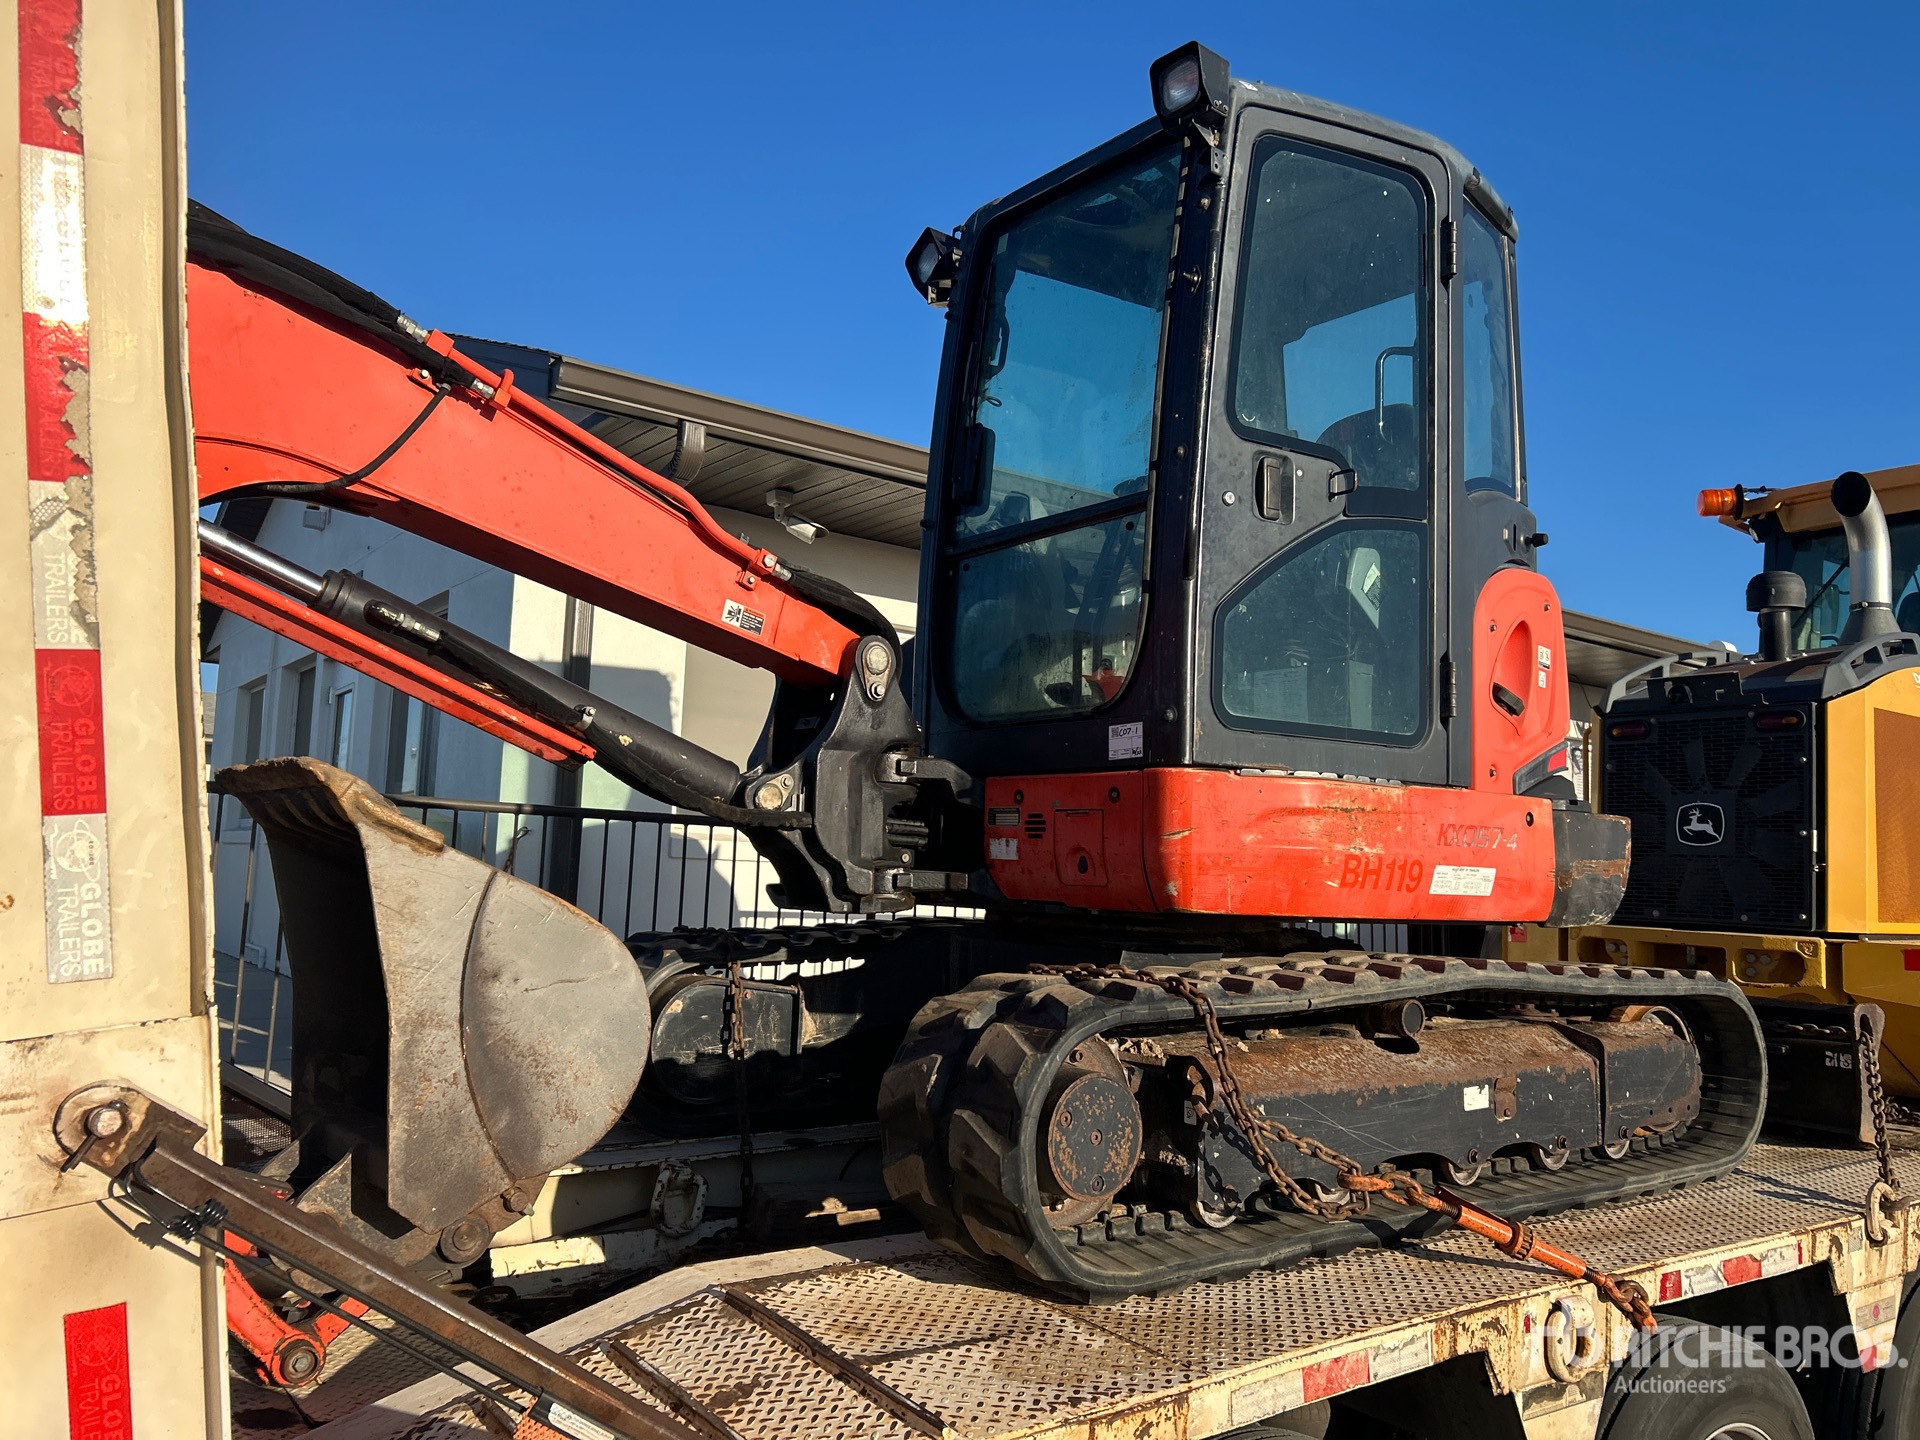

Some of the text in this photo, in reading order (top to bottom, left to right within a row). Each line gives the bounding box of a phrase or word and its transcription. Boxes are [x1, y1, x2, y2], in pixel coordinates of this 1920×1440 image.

[44, 551, 69, 644] TRAILERS
[50, 719, 76, 812] TRAILERS
[73, 717, 98, 811] GLOBE
[1338, 853, 1424, 894] BH119
[1437, 823, 1518, 850] KX057-4
[57, 883, 81, 977] TRAILERS
[80, 881, 104, 975] GLOBE
